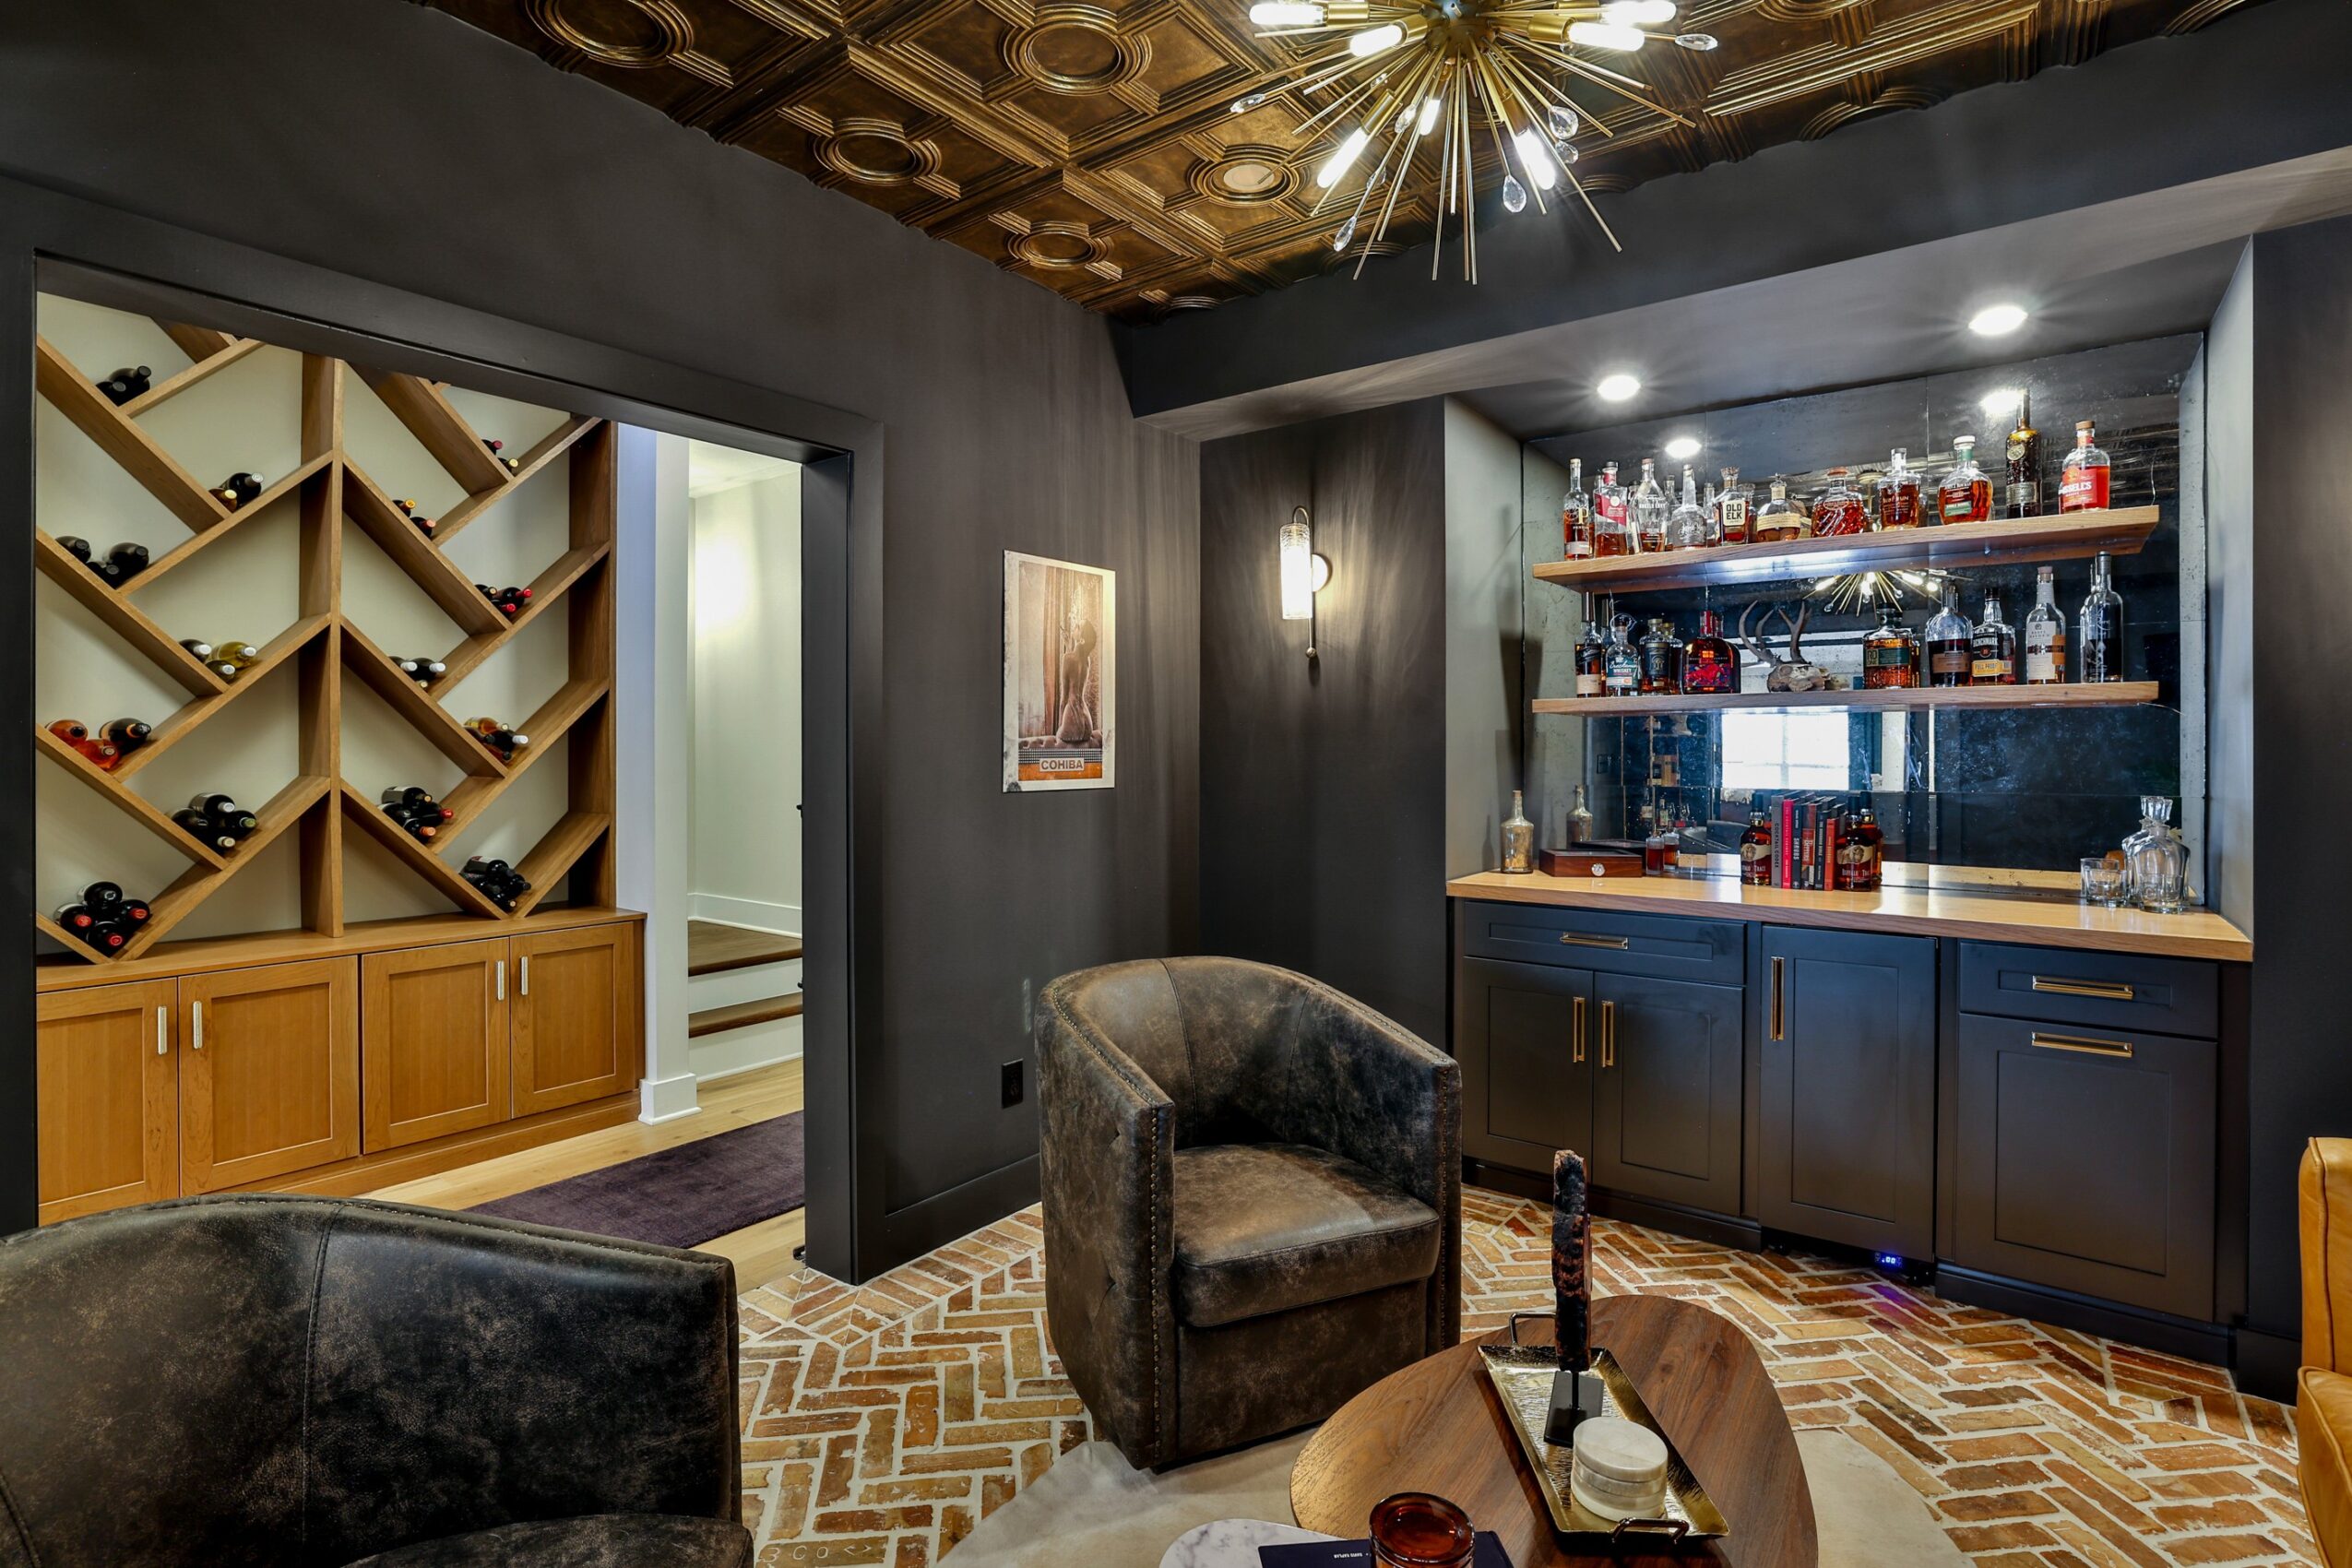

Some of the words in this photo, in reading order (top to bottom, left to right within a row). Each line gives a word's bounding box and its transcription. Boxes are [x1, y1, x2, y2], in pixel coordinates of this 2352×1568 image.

[1726, 503, 1742, 512] OLD
[1726, 512, 1742, 520] ELK
[1040, 759, 1084, 770] COHIBA
